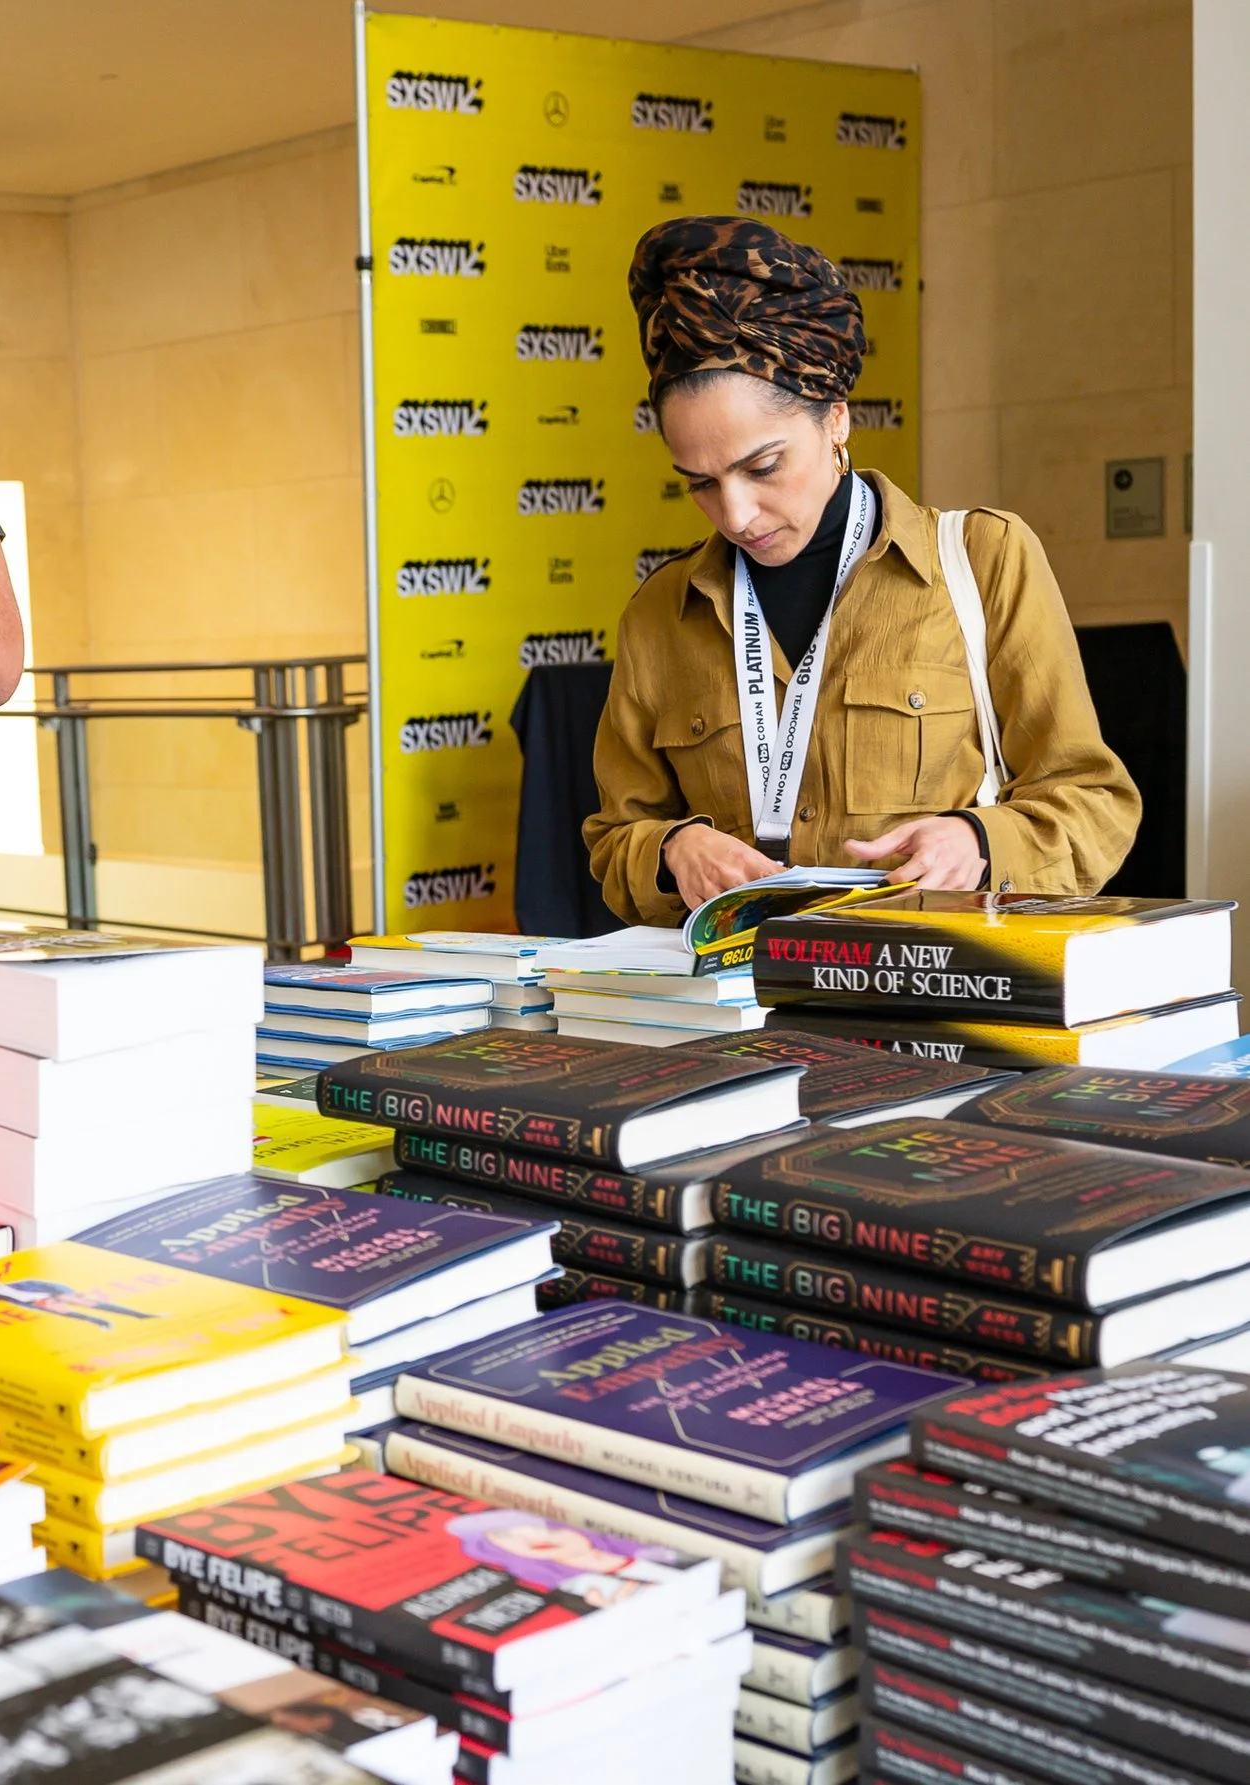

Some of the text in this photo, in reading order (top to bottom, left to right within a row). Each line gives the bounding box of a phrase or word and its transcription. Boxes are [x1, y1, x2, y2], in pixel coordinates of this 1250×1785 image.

[387, 72, 462, 115] SXSW
[631, 95, 694, 133] SXSW
[514, 167, 583, 206] SXSW
[389, 240, 464, 277] SXSW
[516, 328, 585, 361] SXSW
[394, 402, 467, 437] SXSW
[518, 481, 586, 515] SXSW
[839, 541, 857, 577] CONAN
[396, 561, 470, 598] SXSW
[744, 611, 764, 695] PLATINUM
[796, 643, 817, 685] 2019
[400, 715, 472, 754] SXSW
[755, 701, 766, 741] CONAN
[786, 693, 803, 748] TEAMCOCO
[773, 773, 787, 813] CONAN
[404, 867, 474, 909] SXSW
[766, 938, 954, 970] WOLFRAM A NEW
[812, 966, 1013, 1001] KIND OF SCIENCE
[910, 1041, 965, 1064] NEW
[1052, 1076, 1132, 1100] THE
[1136, 1082, 1230, 1118] NINE
[330, 1084, 497, 1136] THE BIG NINE
[527, 1119, 556, 1132] AMY
[409, 1134, 565, 1193] THE BIG NINE
[594, 1176, 621, 1191] AMY
[160, 1193, 309, 1253] Applied
[173, 1197, 347, 1264] Empathy
[728, 1192, 933, 1262] THE BIG NINE
[969, 1244, 1007, 1264] AMY
[725, 1255, 940, 1326] THE BIG NINE
[722, 1306, 778, 1333] THE
[981, 1309, 1019, 1327] AMY
[538, 1326, 698, 1388] Applied
[558, 1333, 746, 1402] Empathy
[413, 1391, 734, 1495] Applied Empathy MICHAEL VENTURA
[401, 1451, 475, 1493] Applied
[150, 1478, 431, 1549] BYE
[162, 1539, 283, 1607] BYE FELIPE
[204, 1601, 244, 1635] BYE
[245, 1618, 315, 1669] FELIPE
